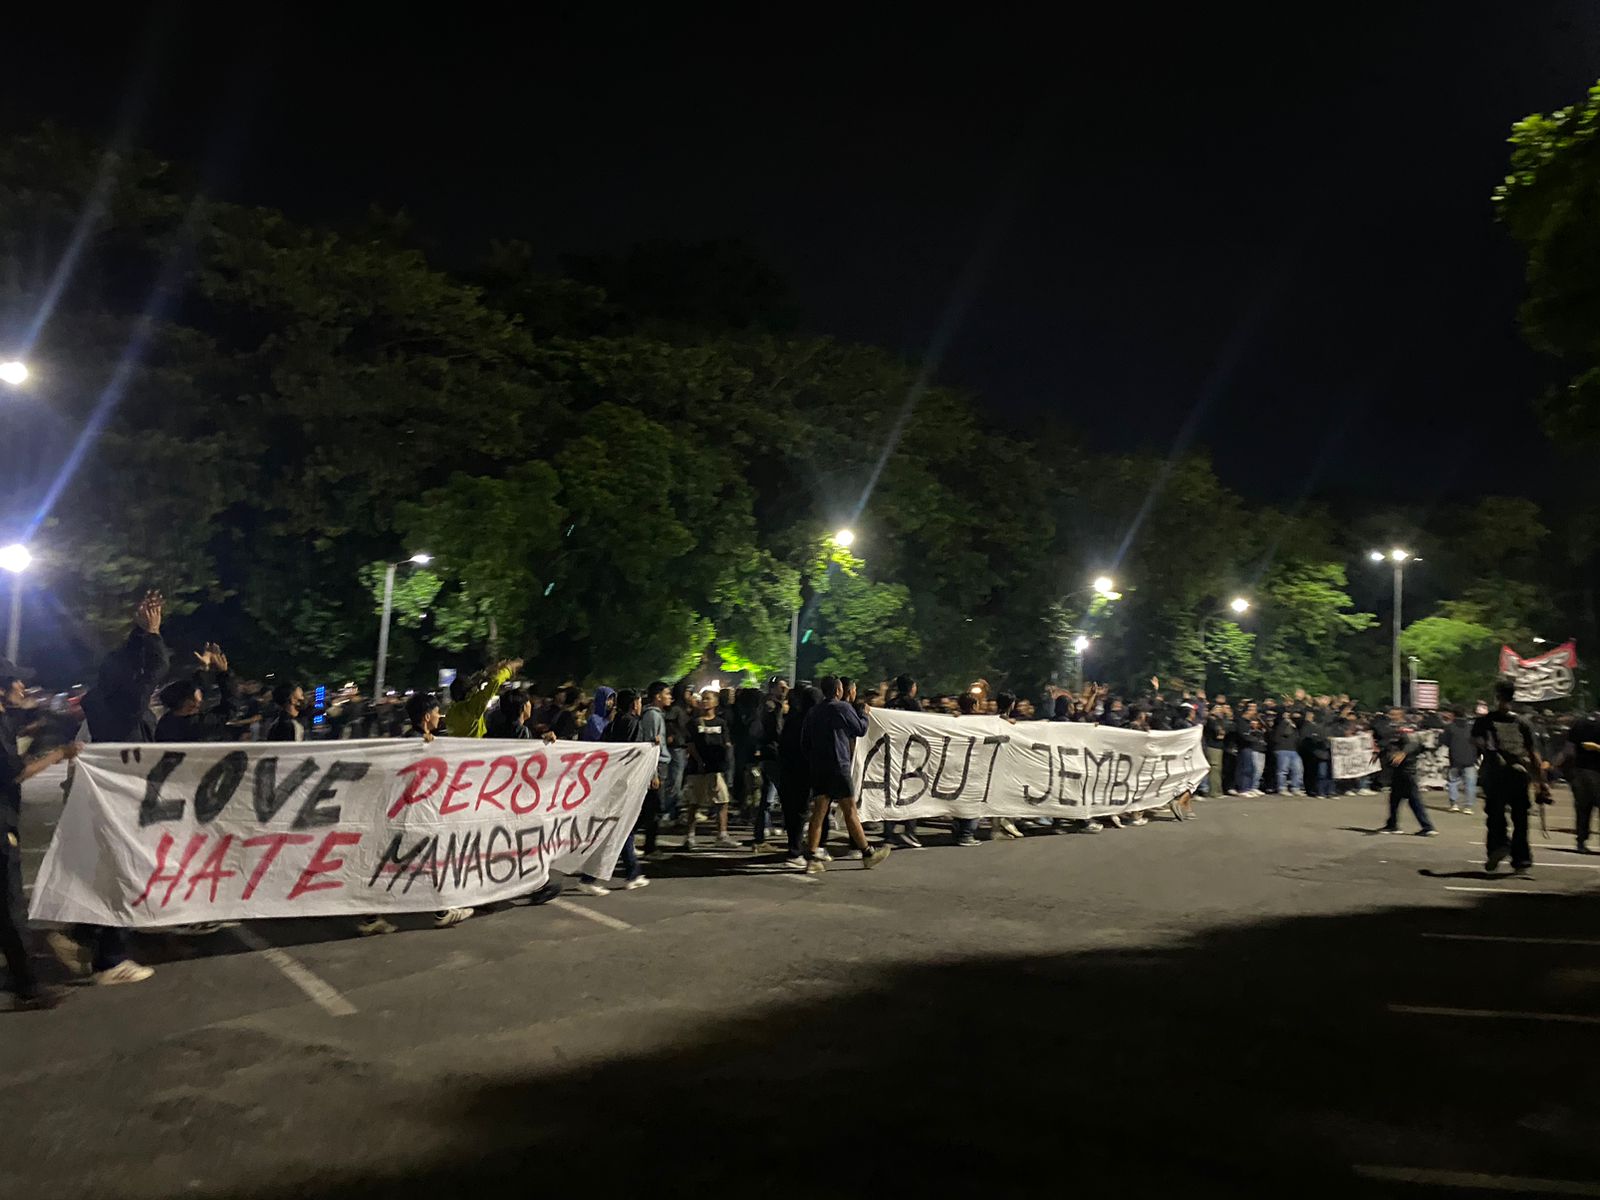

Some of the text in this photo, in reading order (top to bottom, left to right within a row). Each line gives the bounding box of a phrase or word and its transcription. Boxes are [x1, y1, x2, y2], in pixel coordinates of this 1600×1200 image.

[856, 733, 1010, 809] ABUT
[131, 815, 621, 908] HATE MANAGEMENT
